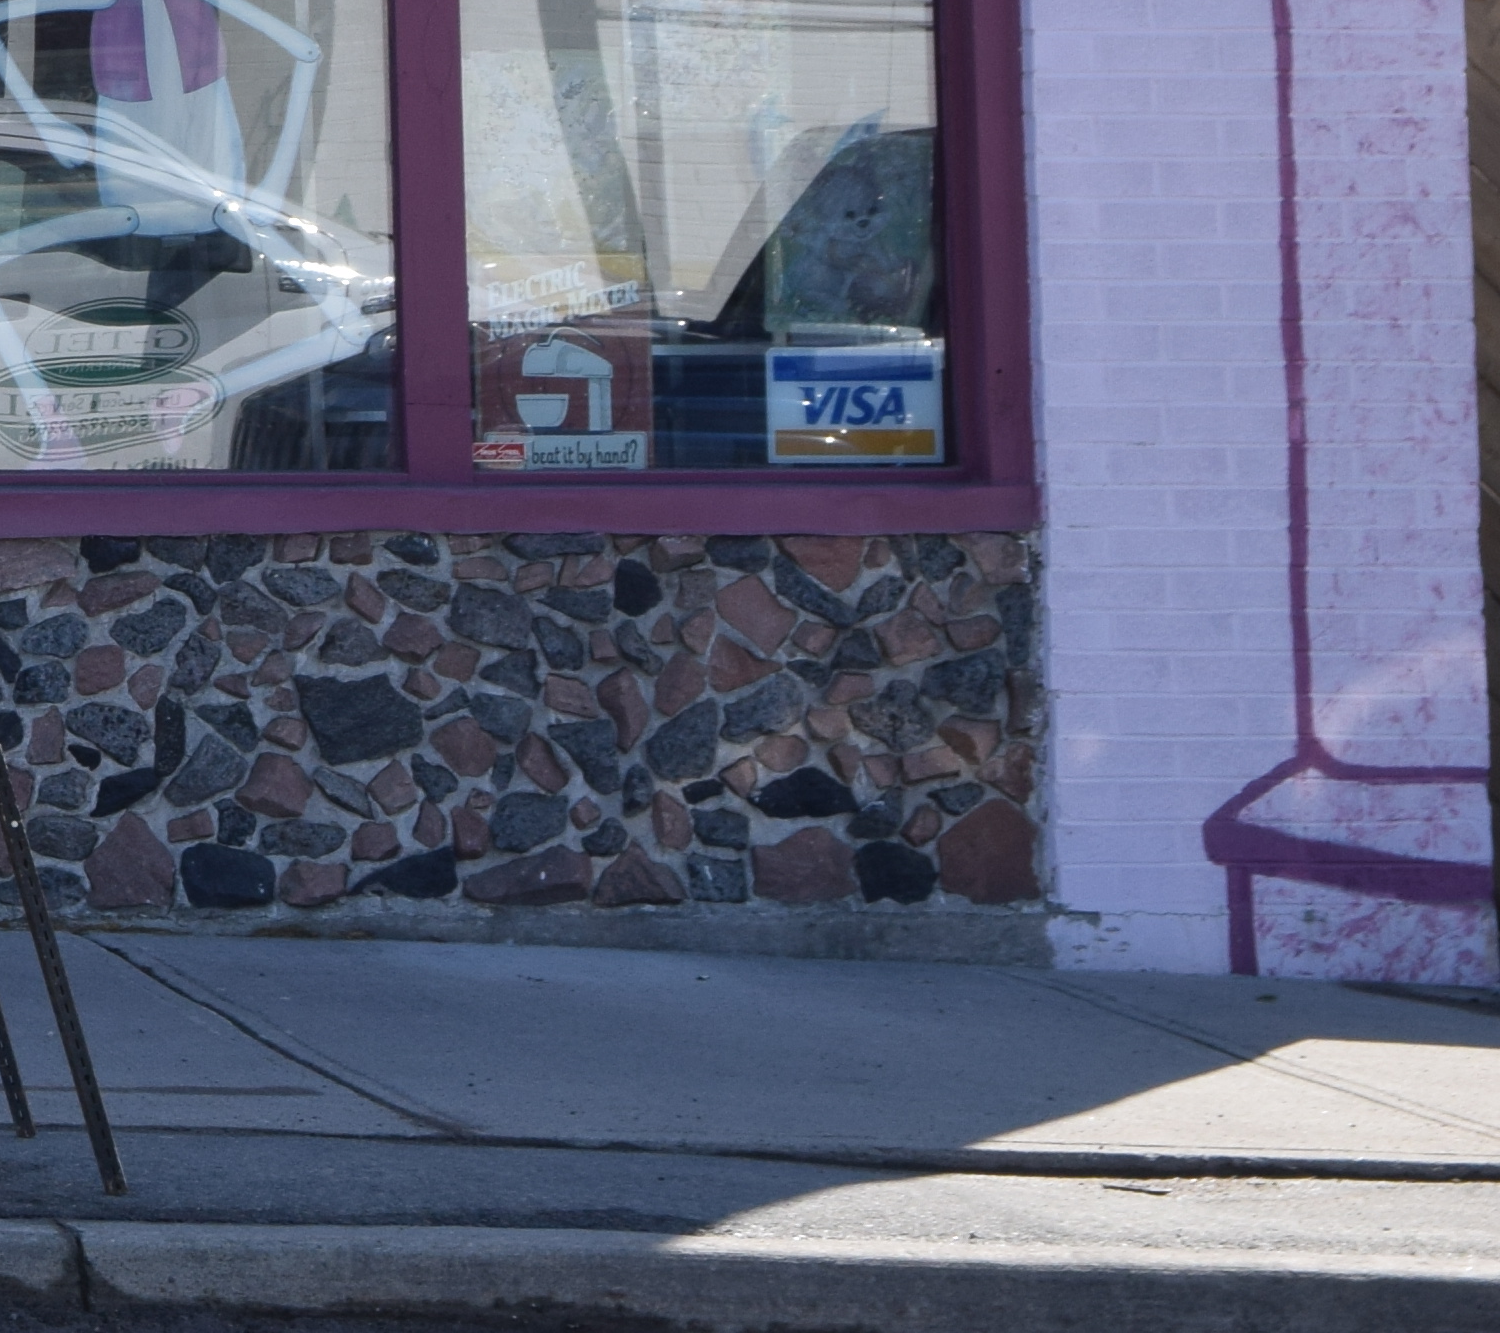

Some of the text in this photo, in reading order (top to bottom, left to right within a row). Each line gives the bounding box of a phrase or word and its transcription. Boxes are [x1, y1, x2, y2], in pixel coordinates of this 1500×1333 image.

[485, 260, 586, 311] ELECTRIC
[797, 385, 906, 425] VISA
[531, 440, 560, 464] beat
[563, 445, 575, 464] it
[577, 441, 593, 468] by
